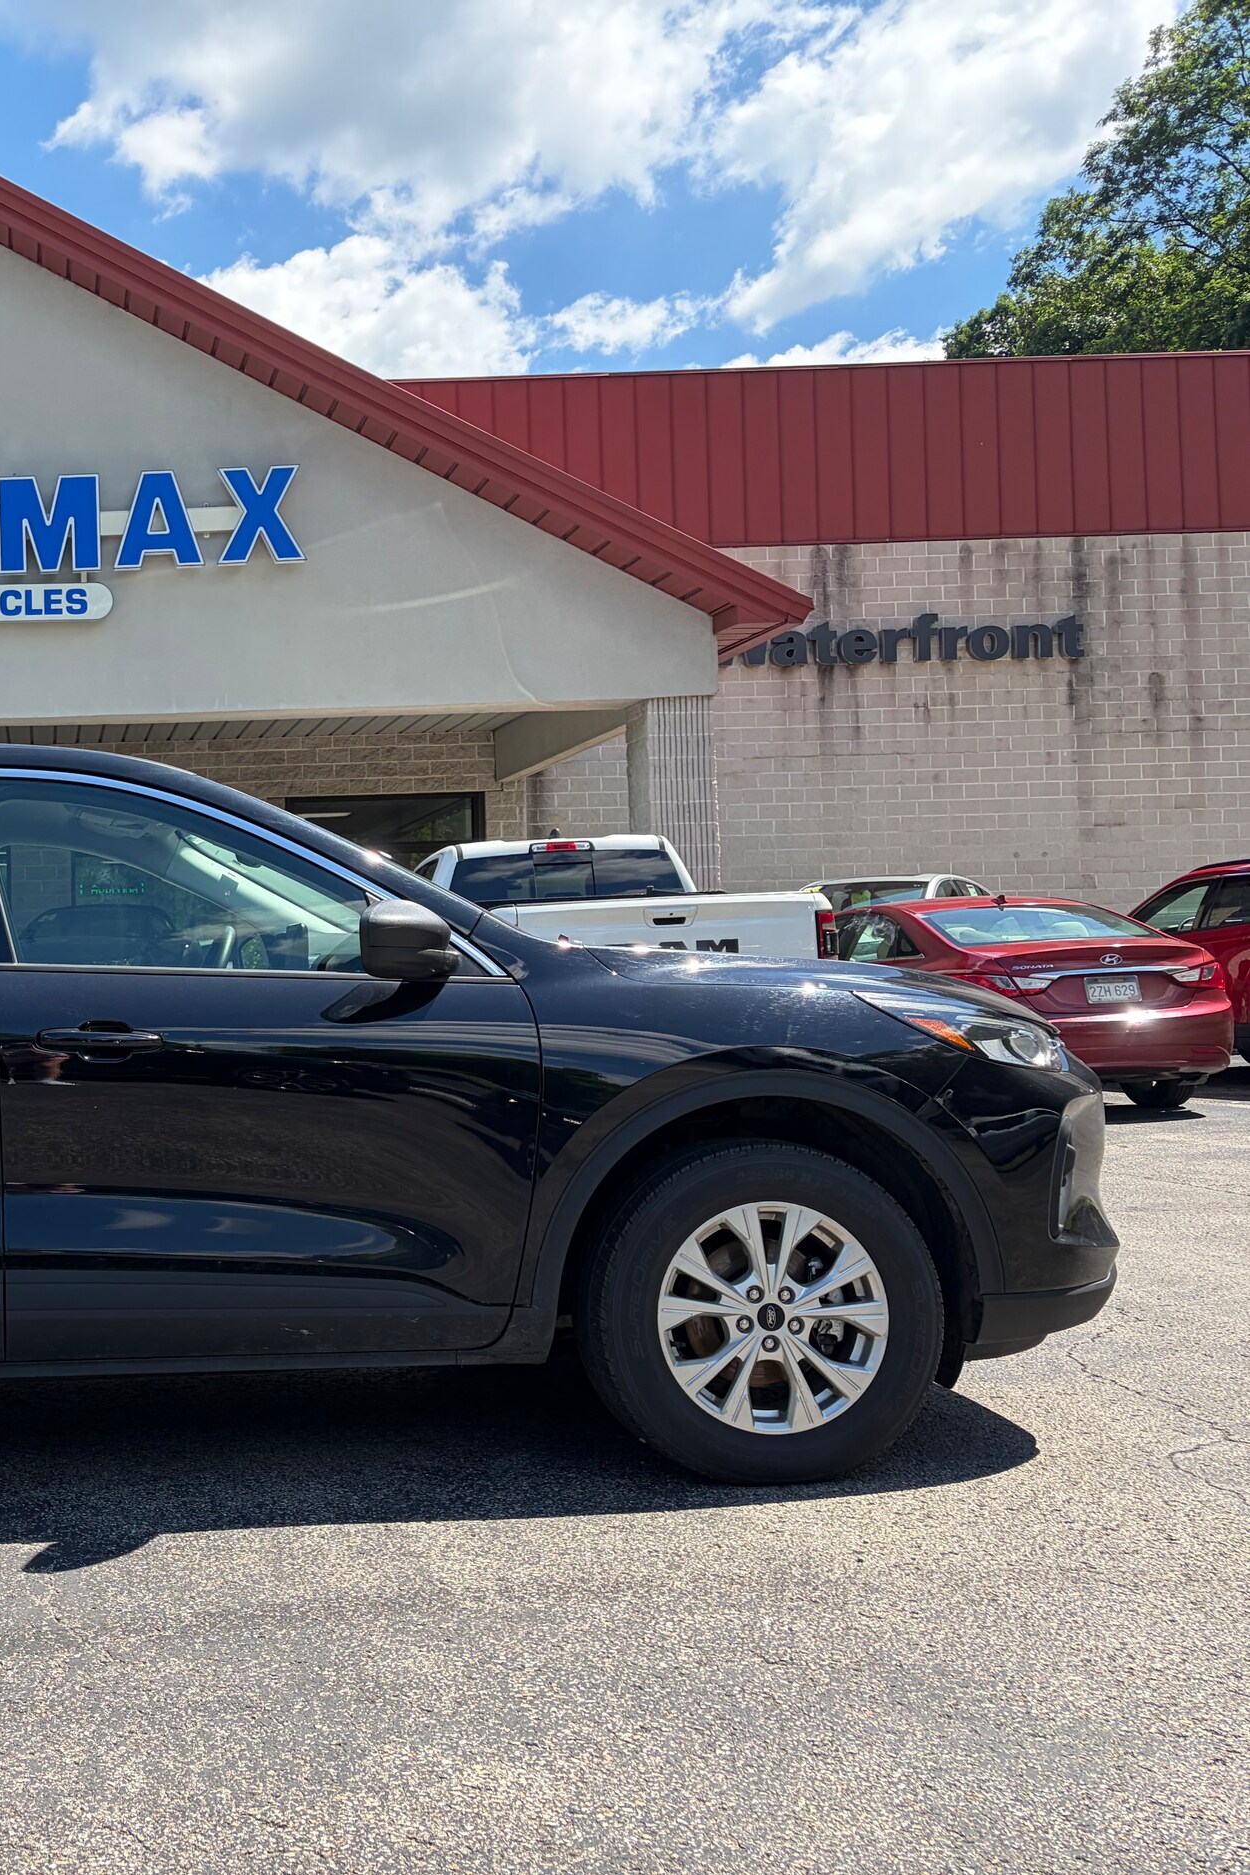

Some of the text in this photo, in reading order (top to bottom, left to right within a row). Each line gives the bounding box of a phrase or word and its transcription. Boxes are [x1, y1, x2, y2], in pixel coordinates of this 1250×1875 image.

[1011, 963, 1054, 971] SONATA
[1089, 984, 1136, 998] 2ZH 629
[623, 1213, 677, 1361] SUREDRIVE
